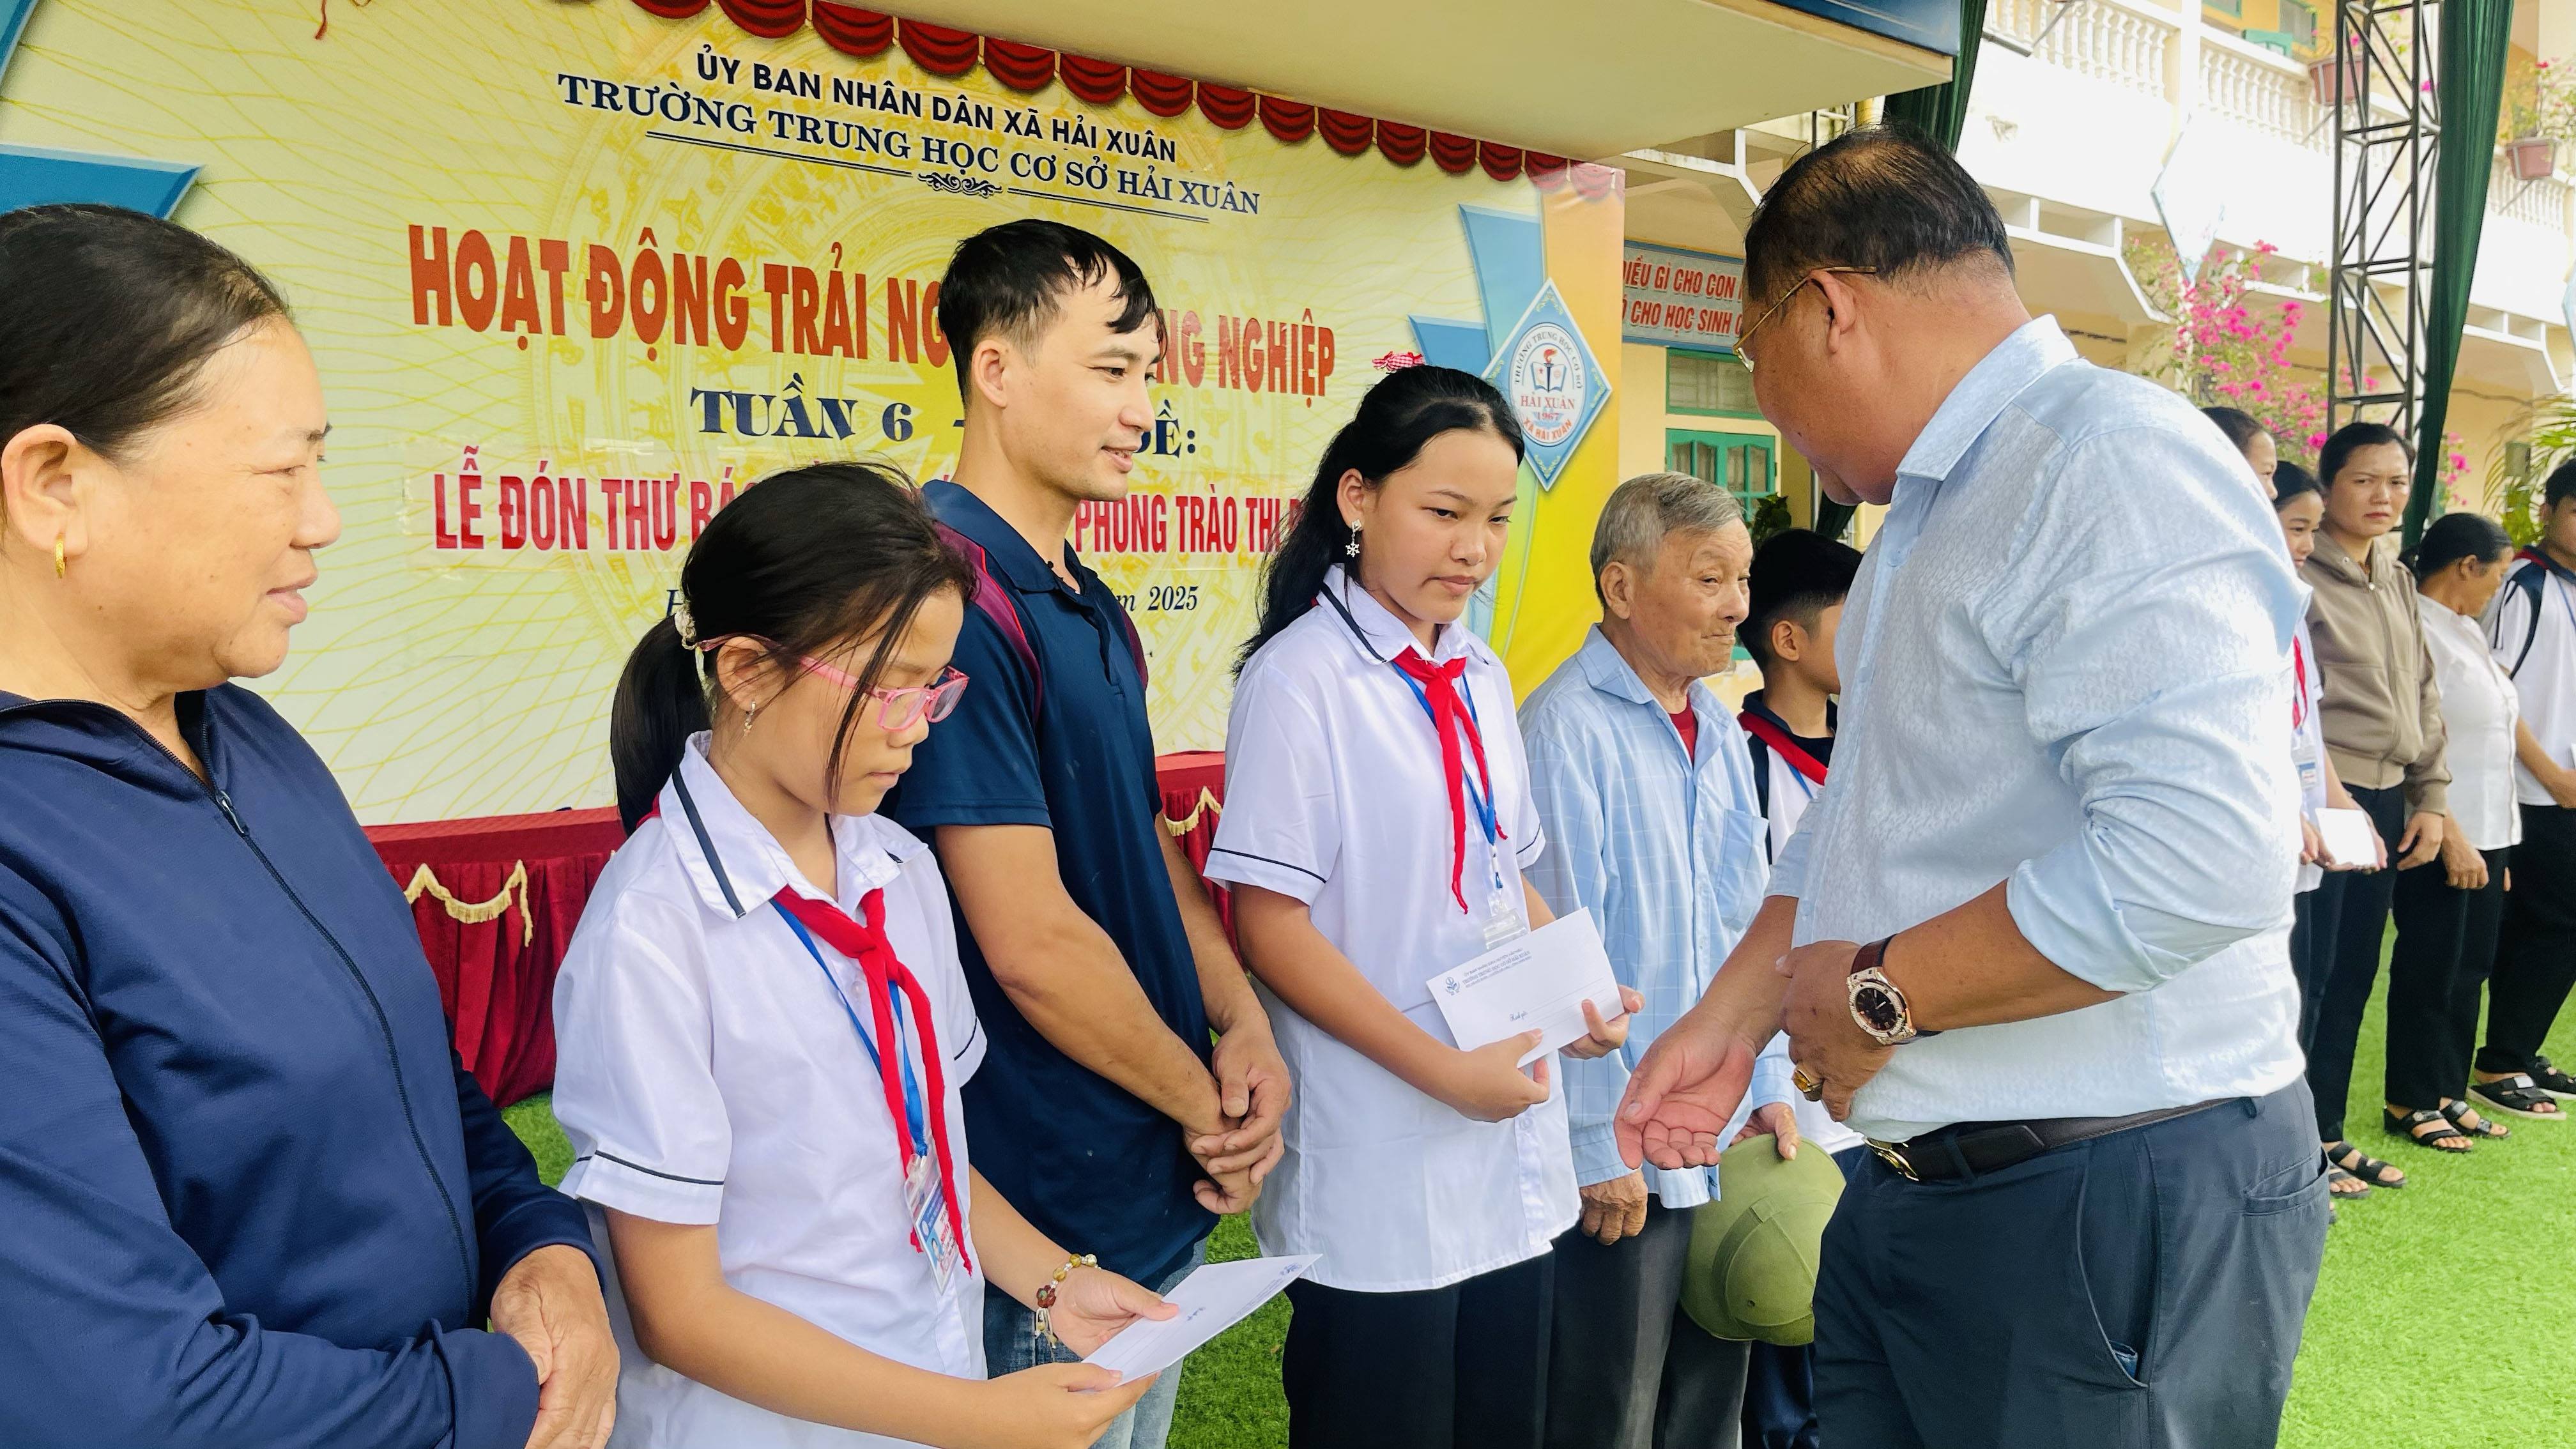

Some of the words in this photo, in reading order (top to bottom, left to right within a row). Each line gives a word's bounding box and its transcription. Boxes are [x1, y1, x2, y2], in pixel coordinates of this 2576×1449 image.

[697, 44, 740, 84] ỦY
[753, 63, 820, 99] BAN
[834, 80, 921, 118] NHÂN
[932, 94, 993, 130] DÂN
[1004, 108, 1043, 139] XÃ
[1052, 115, 1096, 148] HẢI
[1105, 130, 1176, 162] XUÂN
[558, 73, 756, 134] TRƯỜNG
[768, 111, 910, 159] TRUNG
[921, 137, 999, 175] HỌC
[1010, 153, 1057, 181] CƠ
[1066, 155, 1108, 189] SỞ
[1117, 165, 1172, 201] HẢI
[1179, 181, 1260, 215] XUÂN
[408, 224, 569, 351] HOẠT
[586, 226, 749, 362] ĐỘNG
[763, 241, 868, 360] TRẢI
[1218, 308, 1335, 408] NGHIỆP
[1630, 300, 1662, 326] CHO
[1664, 305, 1694, 334] HỌC
[1697, 309, 1733, 334] SINH
[1673, 268, 1703, 295] CHO
[1705, 273, 1736, 299] CON
[689, 372, 858, 441] TUẦN
[882, 402, 914, 442] 6
[1537, 411, 1560, 421] 1967
[434, 446, 484, 549] LỄ
[498, 460, 588, 551] ĐÓN
[601, 473, 680, 551] THƯ
[1176, 484, 1238, 553] TRÀO
[1246, 498, 1280, 553] THI
[1147, 585, 1199, 611] 2025
